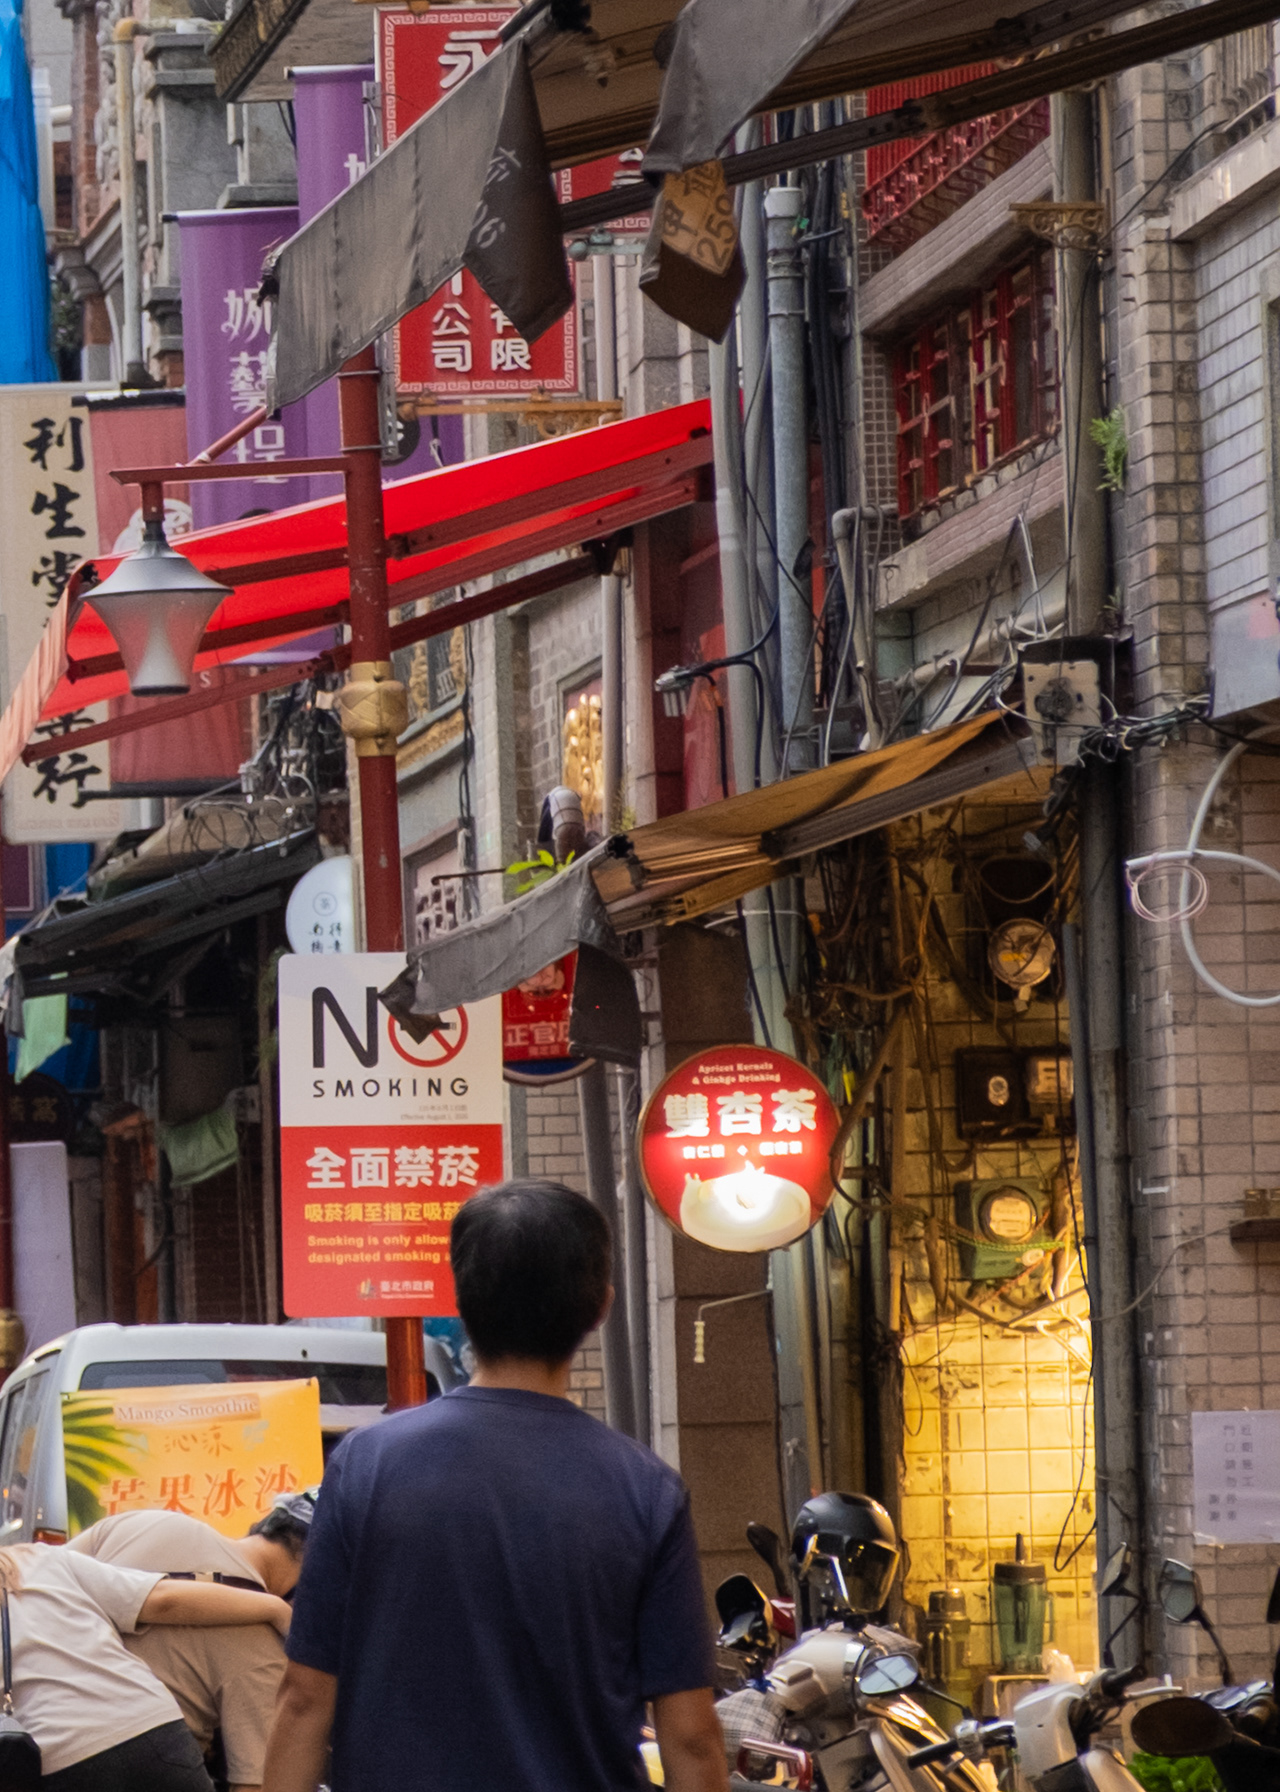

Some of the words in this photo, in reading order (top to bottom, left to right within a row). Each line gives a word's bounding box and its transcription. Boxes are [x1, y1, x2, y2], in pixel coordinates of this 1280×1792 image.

[312, 1077, 470, 1098] SMOKING
[305, 1145, 480, 1189] 全面禁菸
[304, 1201, 462, 1223] 吸菸須至指定吸菸
[307, 1234, 365, 1249] Smoking
[367, 1235, 380, 1247] is
[382, 1233, 411, 1248] only
[414, 1233, 451, 1246] allow
[307, 1250, 381, 1266] designated
[384, 1249, 441, 1264] smoking
[117, 1405, 176, 1422] Mango
[177, 1396, 260, 1418] Smoothie
[163, 1425, 233, 1458] 沁涼
[102, 1463, 299, 1519] 芒果冰沙
